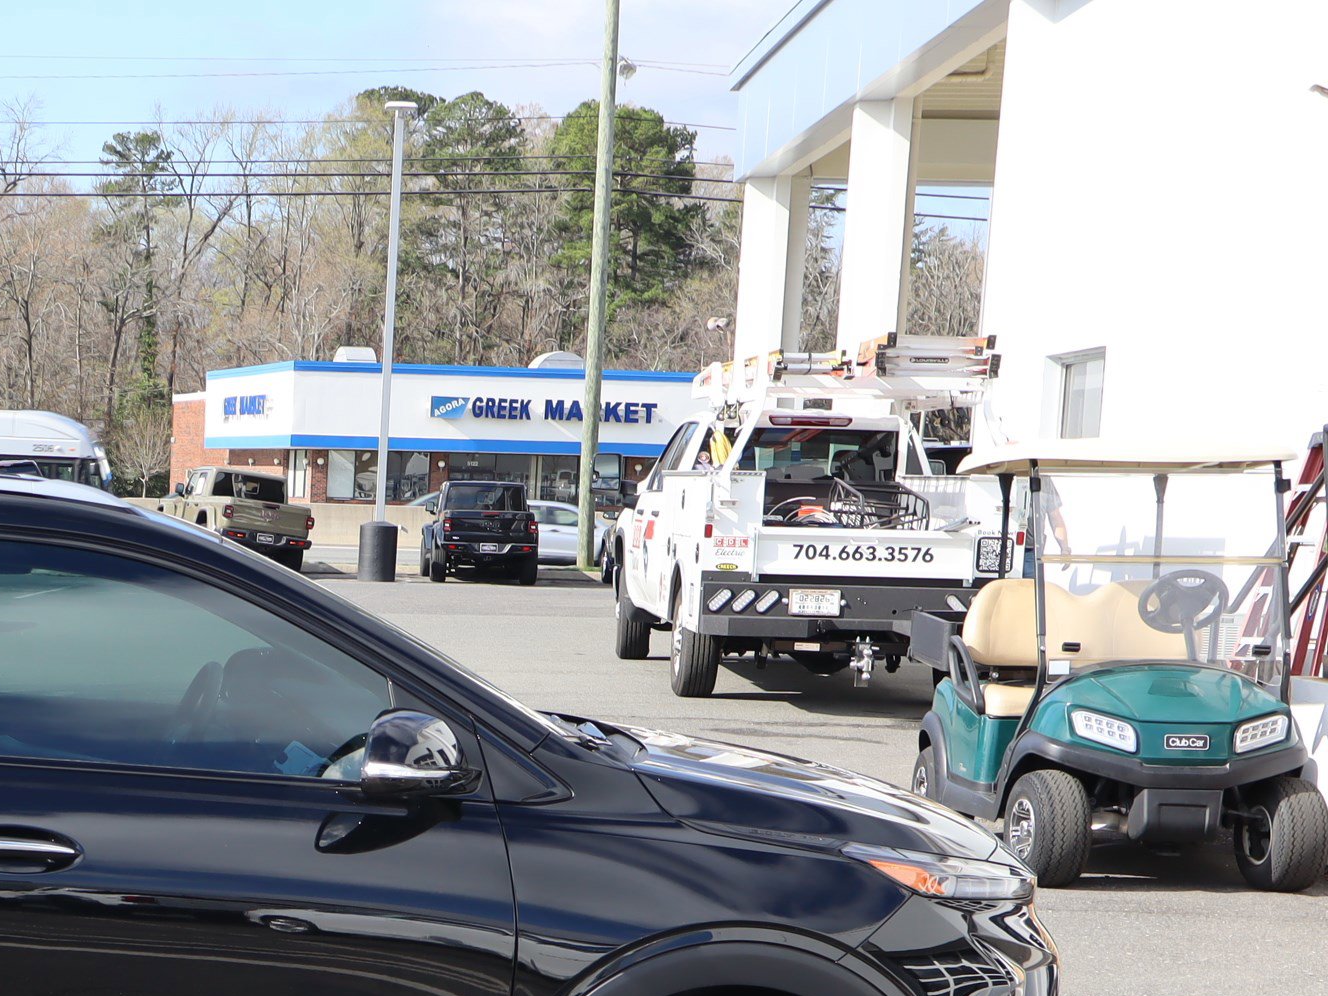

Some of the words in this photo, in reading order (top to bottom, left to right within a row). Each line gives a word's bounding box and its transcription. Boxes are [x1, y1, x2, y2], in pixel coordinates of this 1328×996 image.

[434, 398, 465, 416] AGORA
[472, 397, 532, 420] GREEK
[544, 399, 658, 424] MAKET
[793, 544, 934, 563] 704.663.3576
[1169, 738, 1188, 746] Club
[1190, 738, 1205, 747] Car
